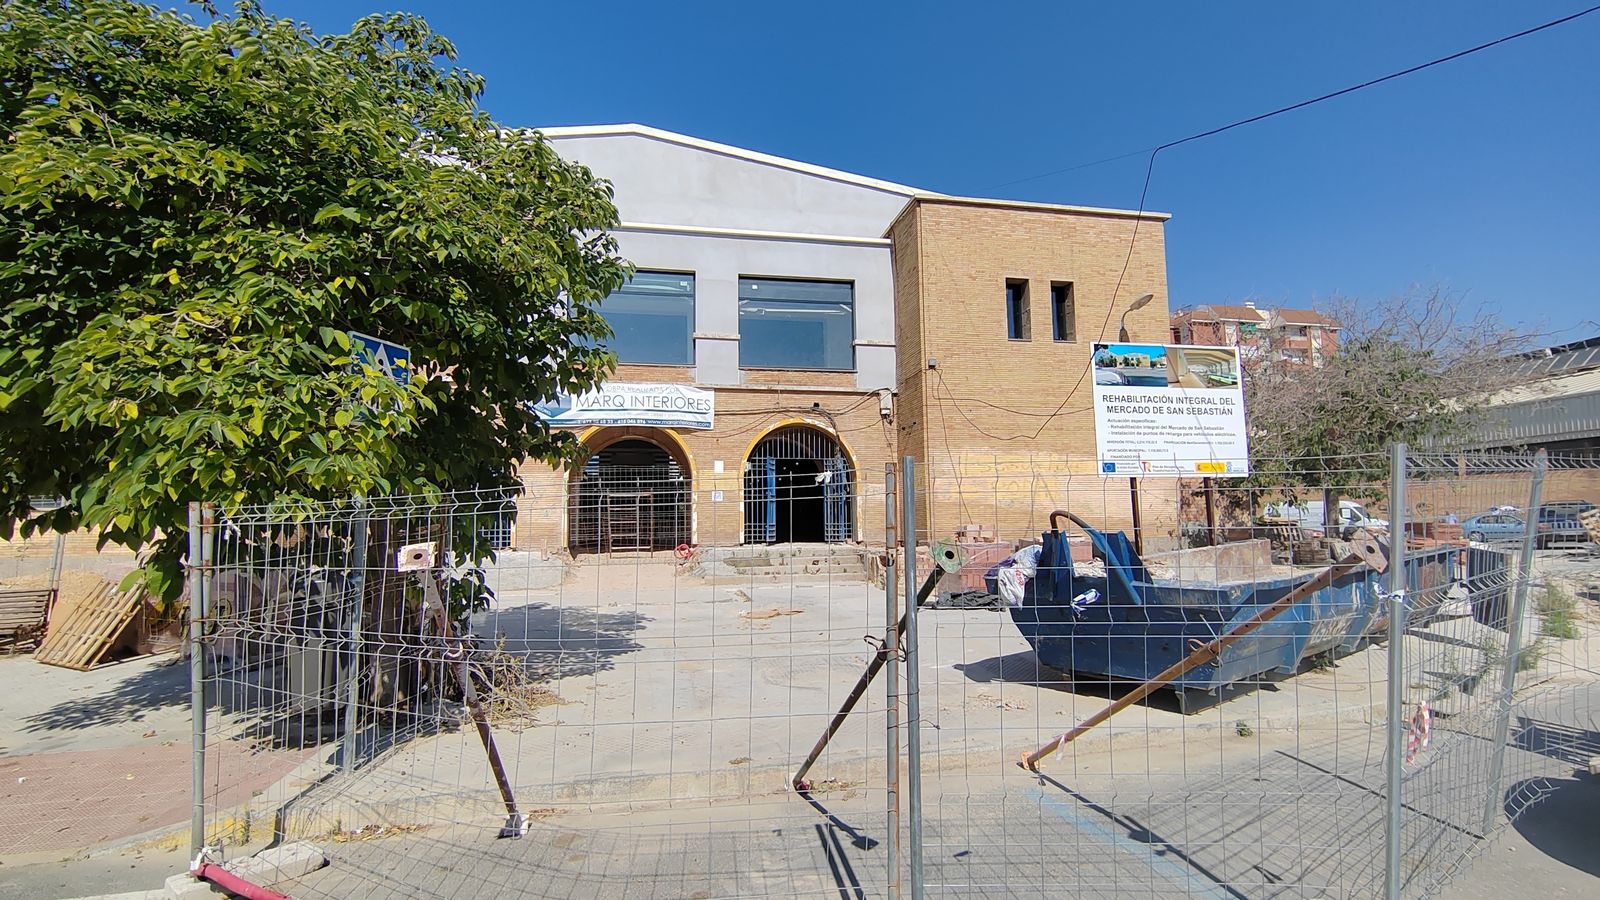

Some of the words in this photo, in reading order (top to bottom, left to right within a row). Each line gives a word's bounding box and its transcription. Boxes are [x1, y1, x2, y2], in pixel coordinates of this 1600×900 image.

[576, 394, 625, 408] MARQ
[631, 395, 711, 411] INTERIORES
[1102, 394, 1173, 404] REHABILITACIÓN
[1176, 396, 1217, 405] INTEGRAL
[1219, 397, 1236, 406] DEL
[1106, 405, 1150, 414] MERCADO
[1153, 406, 1164, 414] DE
[1166, 406, 1184, 415] SAN
[1186, 406, 1233, 416] SEBASTIÁN
